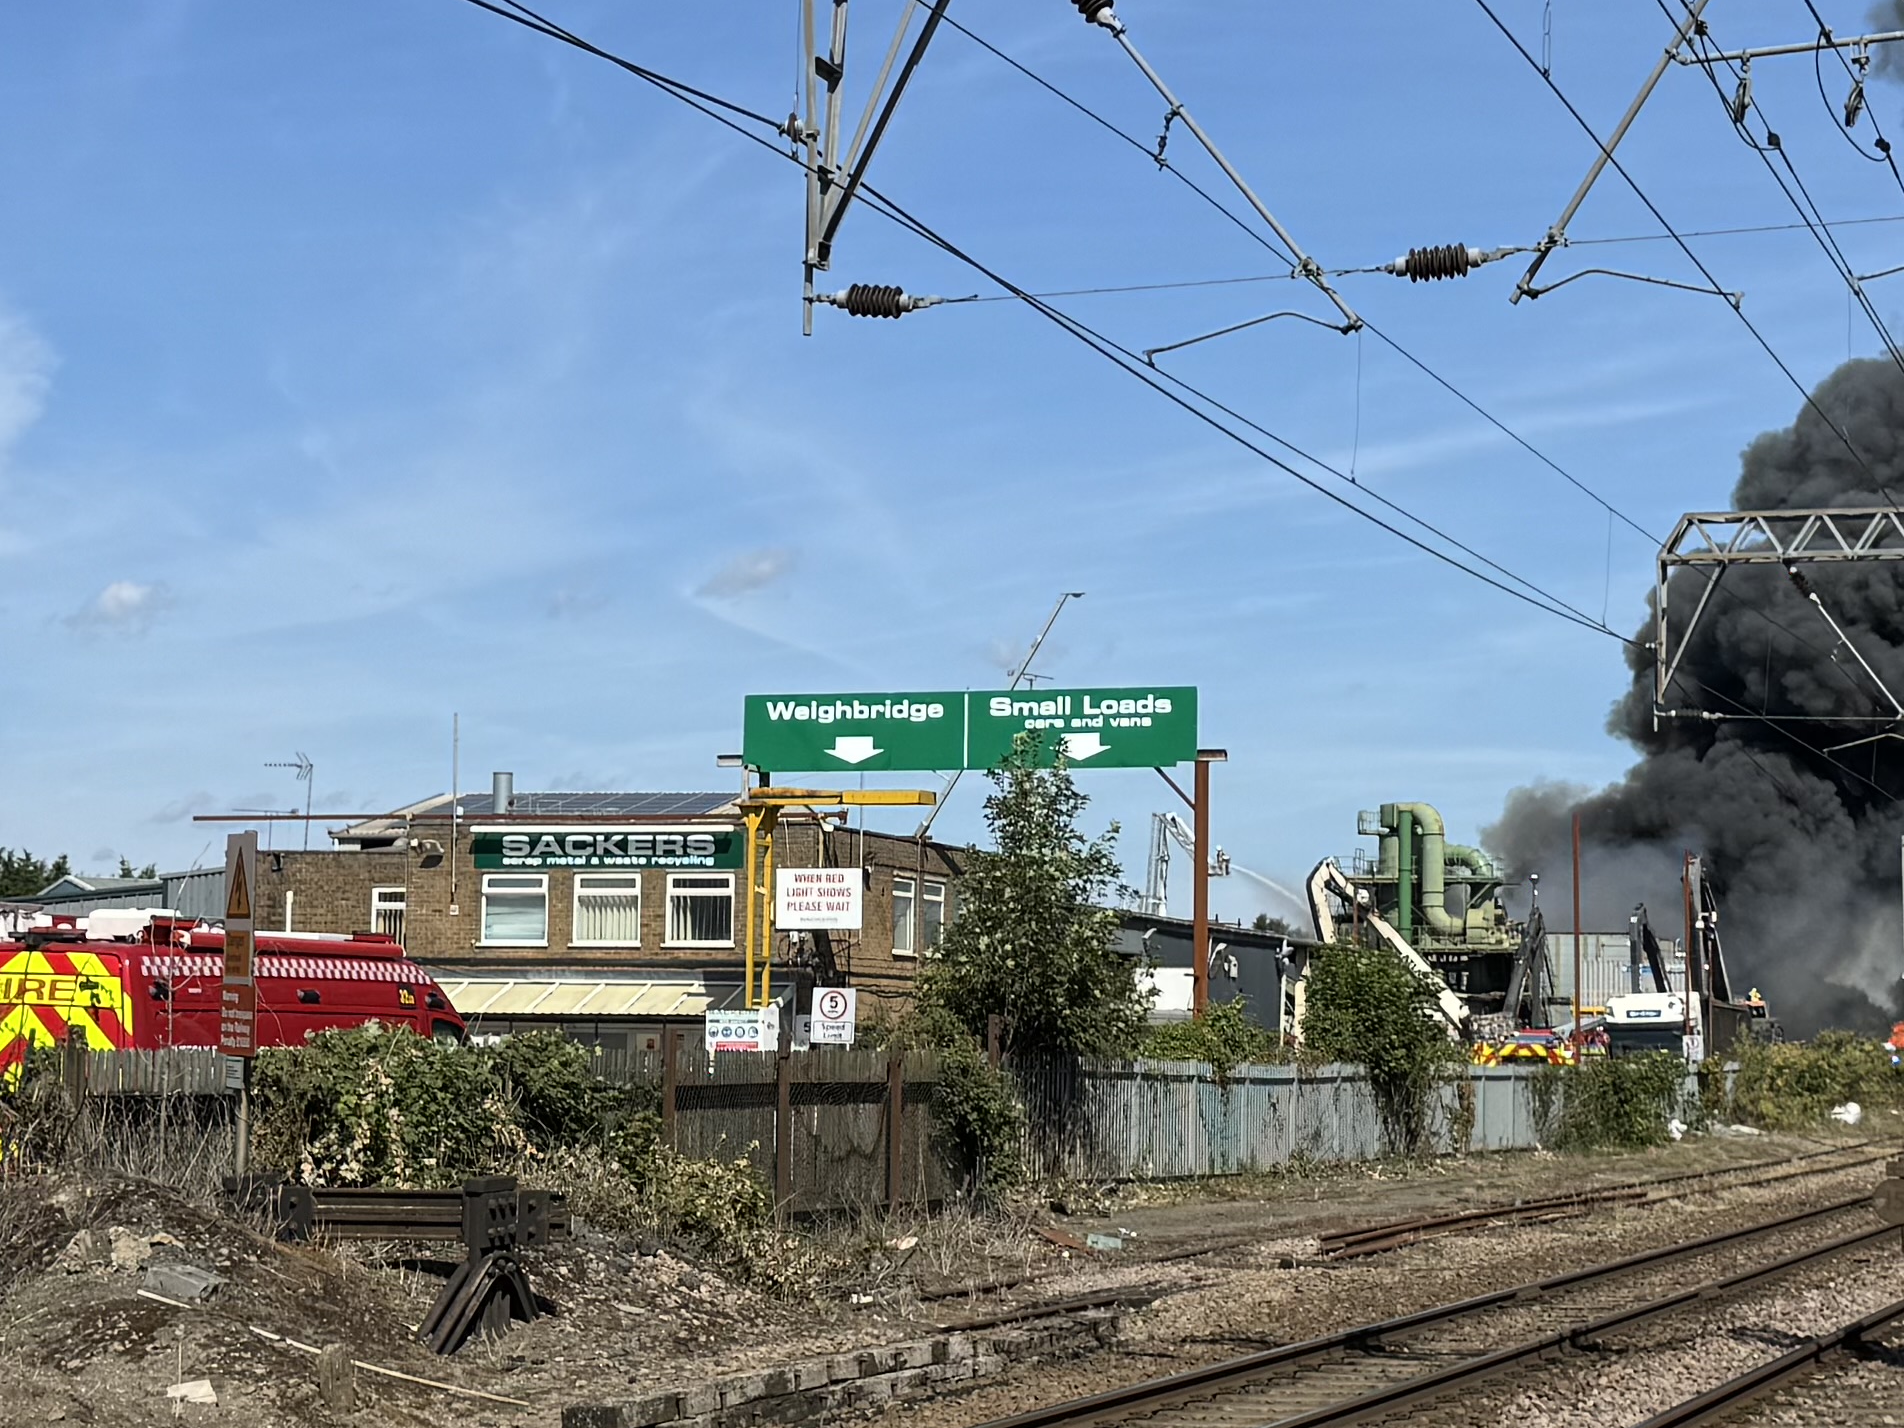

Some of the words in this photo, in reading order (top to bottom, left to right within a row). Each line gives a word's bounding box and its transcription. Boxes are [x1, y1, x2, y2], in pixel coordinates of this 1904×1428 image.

[766, 699, 944, 724] Weighbridge
[989, 696, 1071, 717] Small
[1083, 694, 1172, 715] Loads
[1024, 718, 1065, 729] cars
[1070, 715, 1104, 728] and
[1109, 717, 1152, 727] vans
[502, 834, 715, 857] SACKERS
[502, 856, 542, 867] scrap
[546, 855, 586, 865] metal
[603, 856, 647, 866] waste
[651, 855, 715, 867] recycling
[794, 873, 822, 883] WHEN
[825, 873, 845, 883] RED
[786, 887, 814, 897] LIGHT
[817, 887, 852, 897] SHOWS
[787, 901, 822, 912] PLEASE
[826, 901, 850, 912] WAIT
[829, 995, 839, 1009] 5
[822, 1021, 845, 1031] Speed
